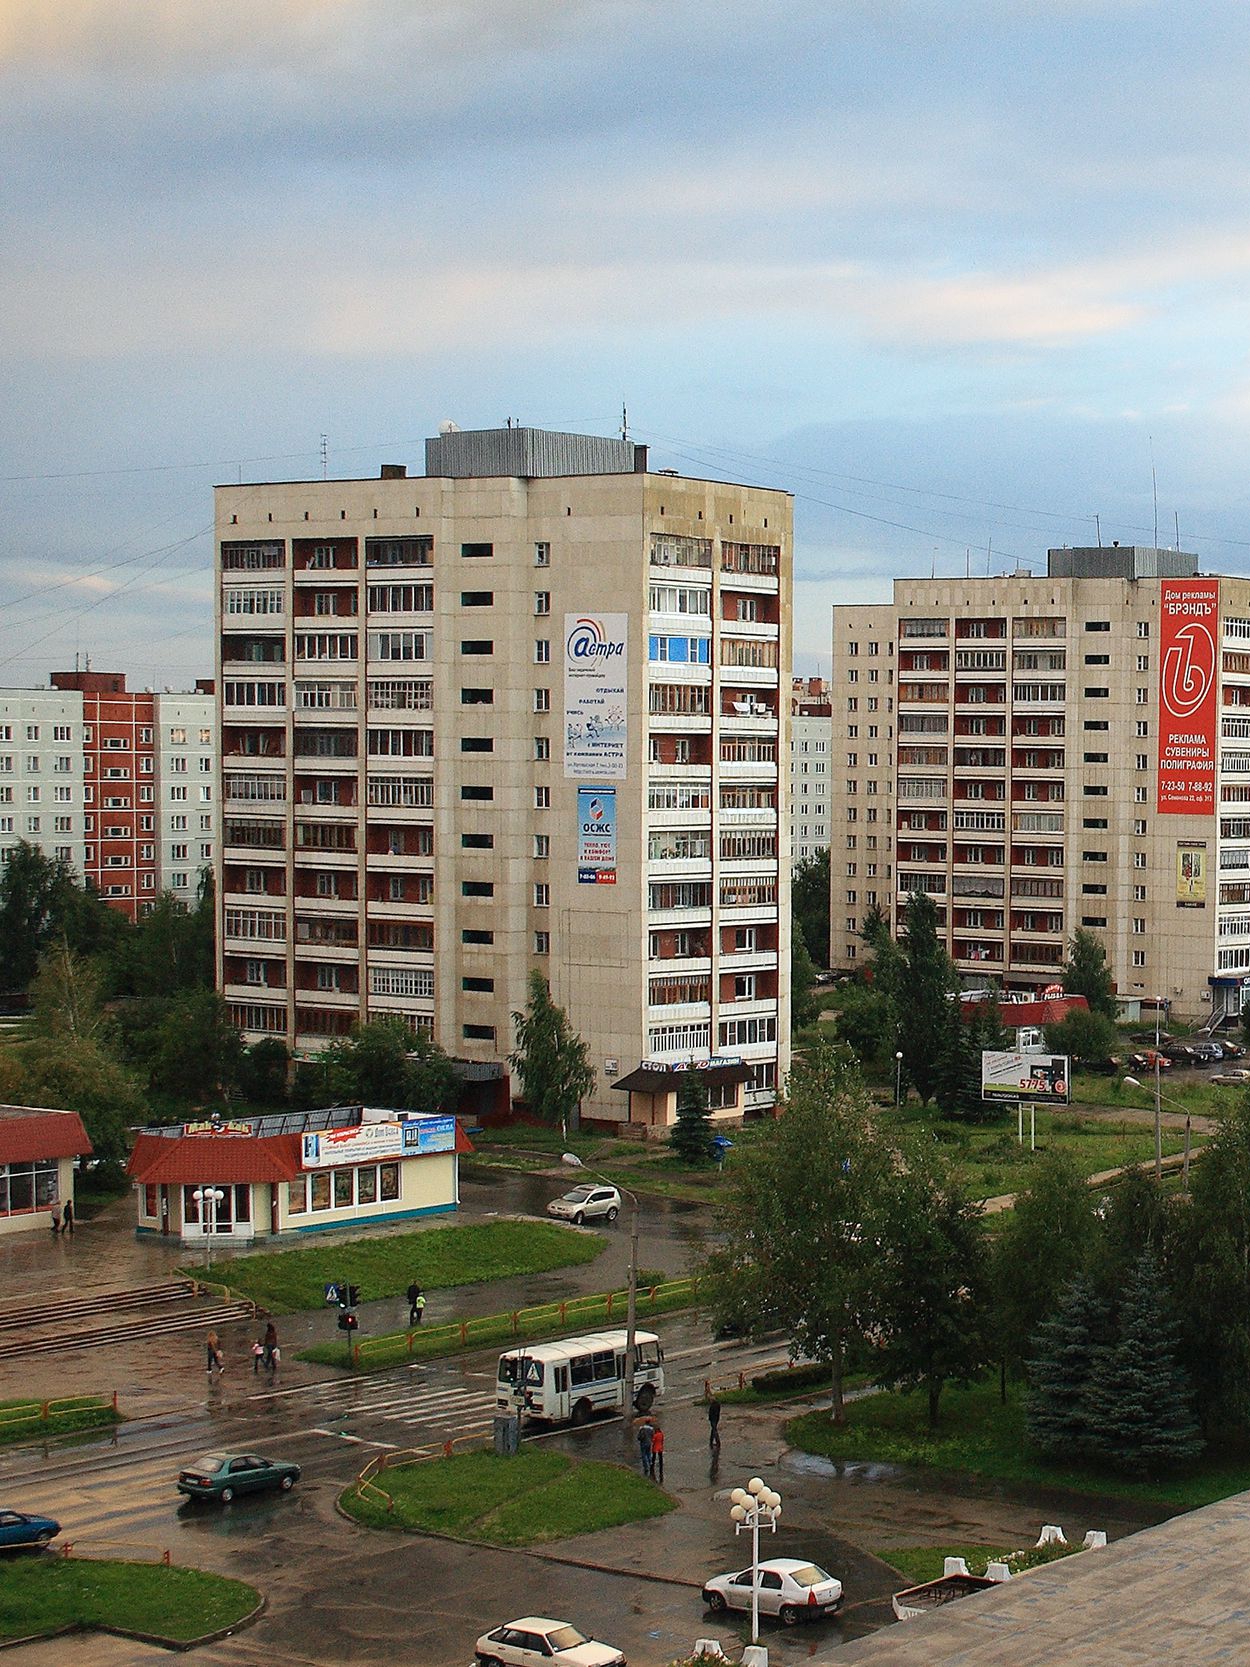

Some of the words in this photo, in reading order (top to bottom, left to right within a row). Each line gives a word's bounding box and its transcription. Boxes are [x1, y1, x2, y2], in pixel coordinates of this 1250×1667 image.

[1165, 590, 1181, 601] Дом
[1169, 734, 1206, 744] РЕКЛАМА
[1165, 747, 1209, 757] СУВЕНИРЫ
[1160, 760, 1214, 770] ПОЛИГРАФИЯ
[583, 824, 611, 833] ОСЖС
